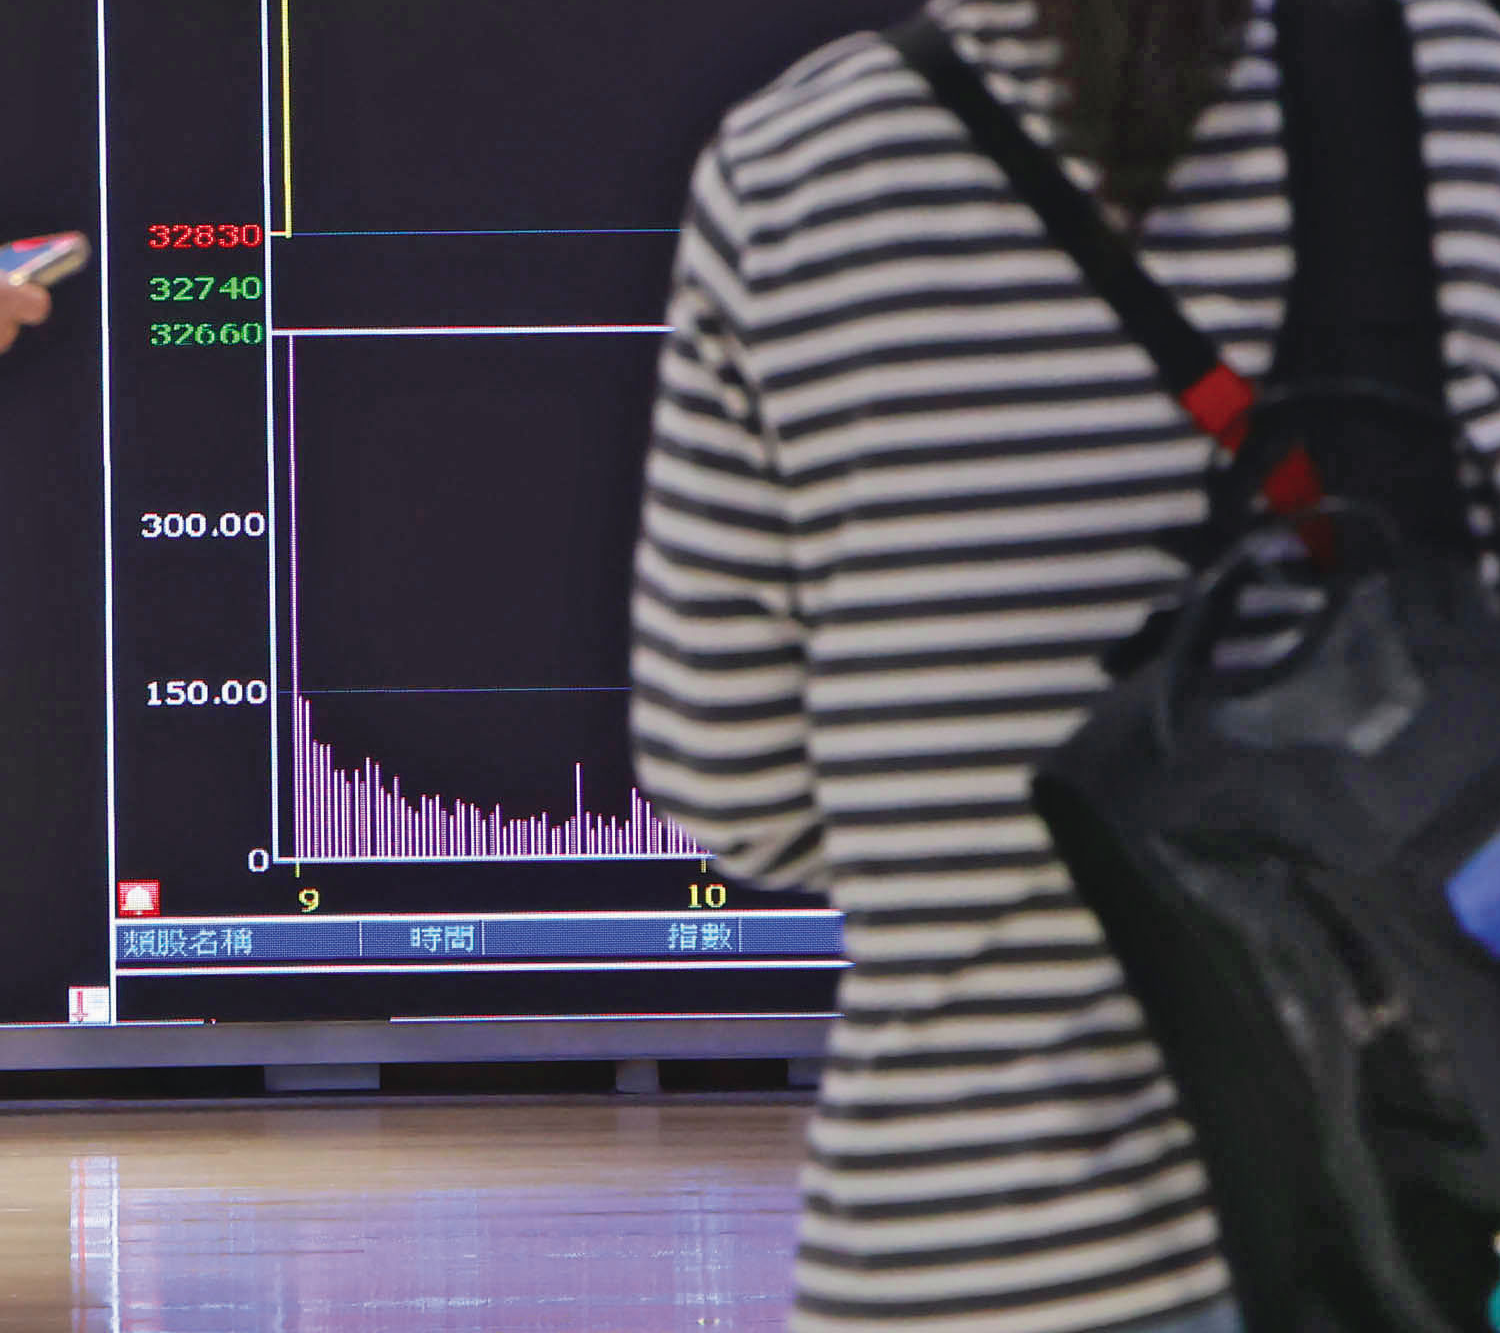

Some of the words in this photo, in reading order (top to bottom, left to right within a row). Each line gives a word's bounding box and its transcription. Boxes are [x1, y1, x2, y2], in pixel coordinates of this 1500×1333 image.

[149, 276, 263, 302] 32740
[140, 511, 266, 539] 300.00
[147, 679, 269, 707] 150.00
